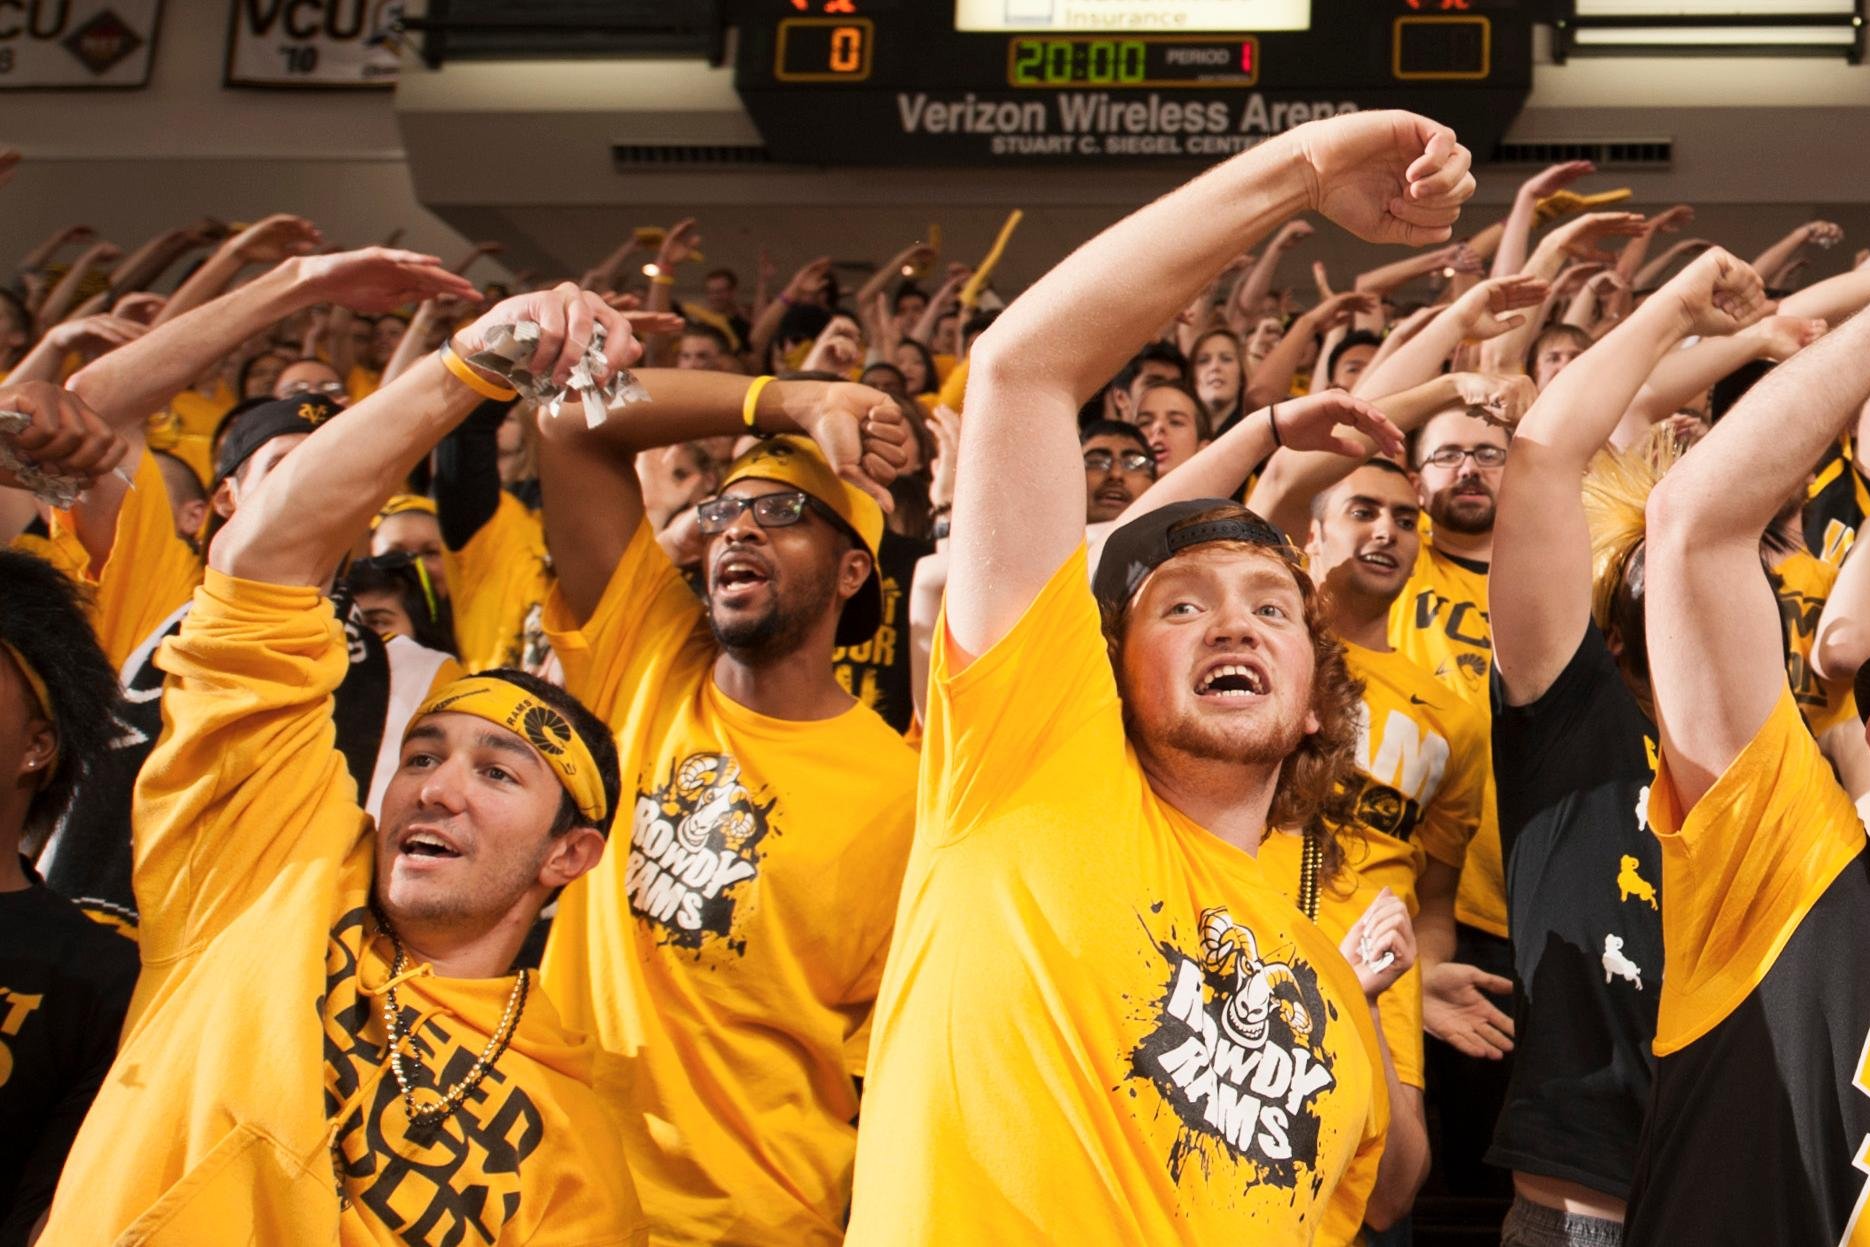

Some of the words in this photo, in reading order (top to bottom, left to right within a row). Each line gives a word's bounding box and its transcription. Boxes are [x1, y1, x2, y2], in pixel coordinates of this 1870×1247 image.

[247, 0, 370, 41] VCU
[1065, 9, 1188, 25] Insurance
[1016, 41, 1147, 84] 20:00
[1166, 49, 1230, 65] PERIOD
[897, 94, 1047, 134] Verizon
[1057, 94, 1230, 134] Wireless
[1240, 93, 1360, 133] Are
[991, 136, 1075, 154] STUART
[1079, 136, 1100, 154] C.
[1105, 136, 1182, 154] SIEGEL
[1186, 135, 1272, 154] CENT
[1415, 589, 1493, 650] VC
[506, 699, 533, 728] RAMS
[632, 796, 757, 900] ROWDY
[625, 852, 704, 931] RAMS
[1156, 1035, 1293, 1160] RAMS
